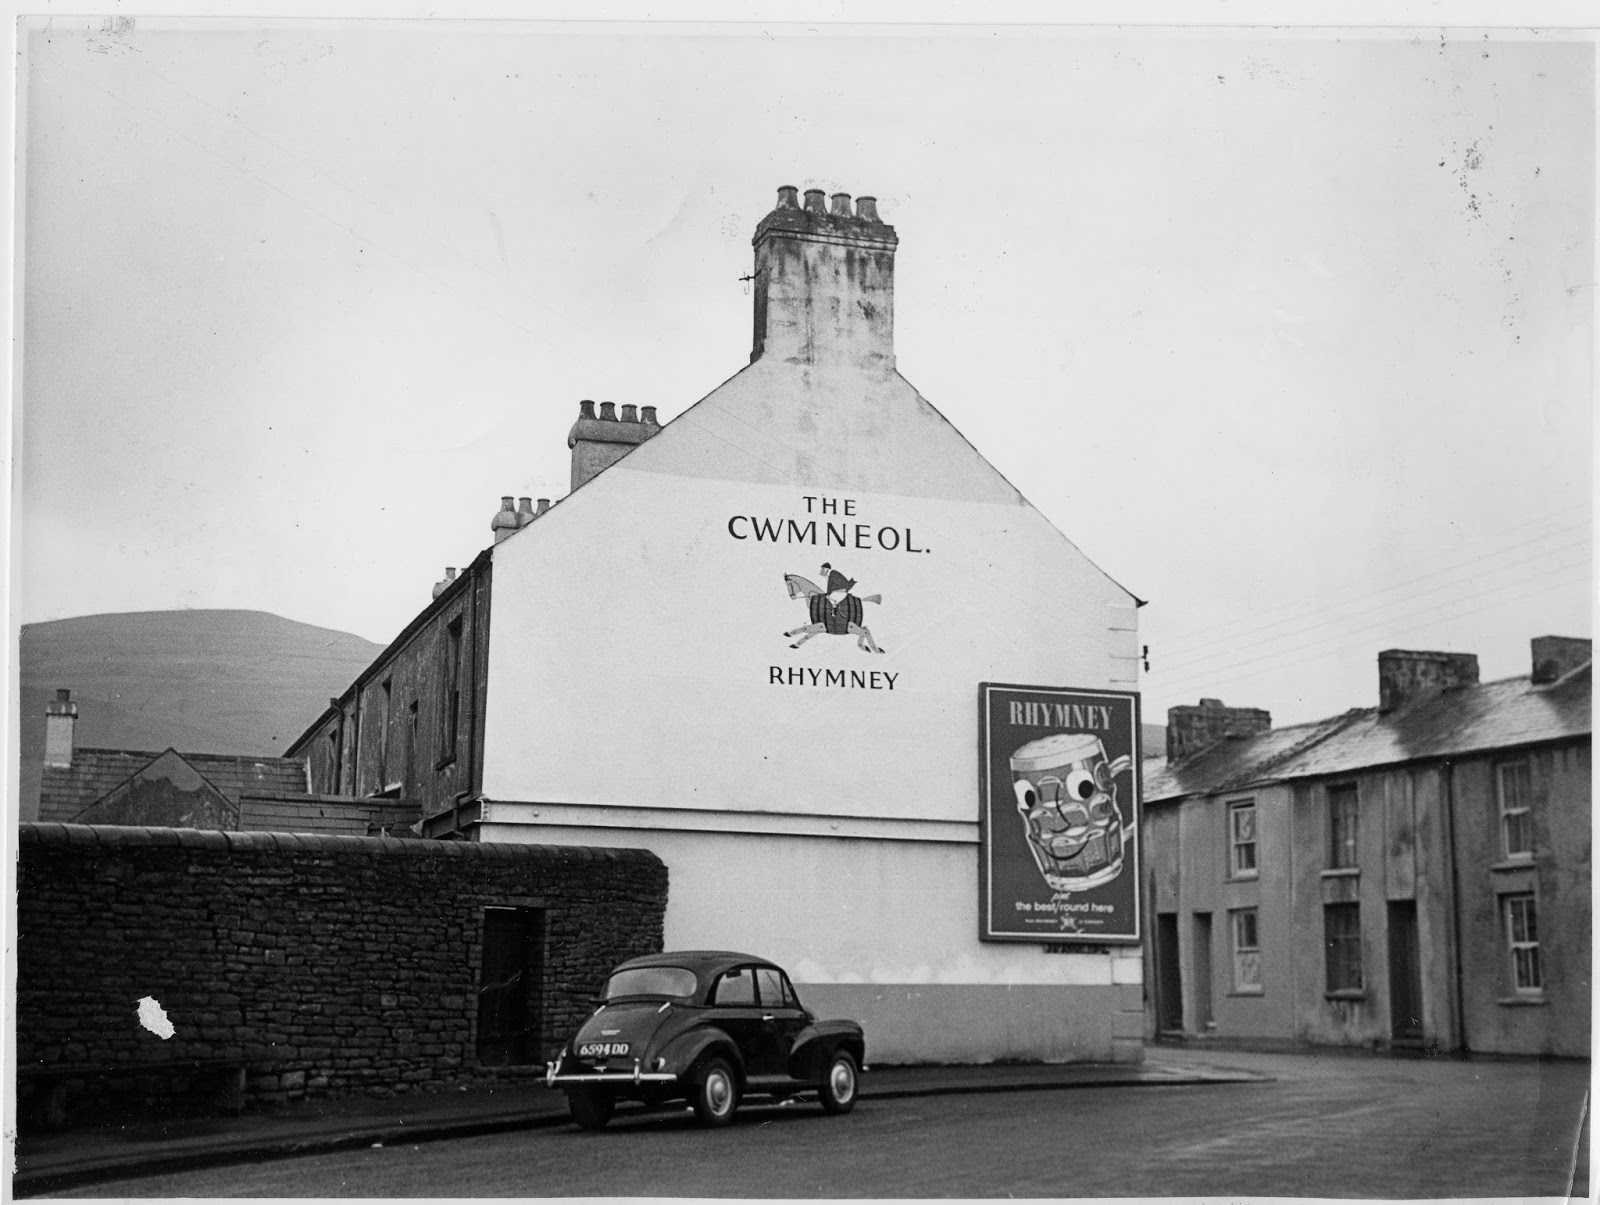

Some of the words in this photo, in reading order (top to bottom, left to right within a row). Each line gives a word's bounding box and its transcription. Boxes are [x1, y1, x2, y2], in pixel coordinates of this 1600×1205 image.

[802, 496, 857, 516] THE
[769, 666, 900, 690] RHYMNEY
[1009, 700, 1114, 730] RHYMNEY
[1015, 901, 1032, 911] the
[1060, 902, 1090, 913] round
[1091, 902, 1114, 914] here
